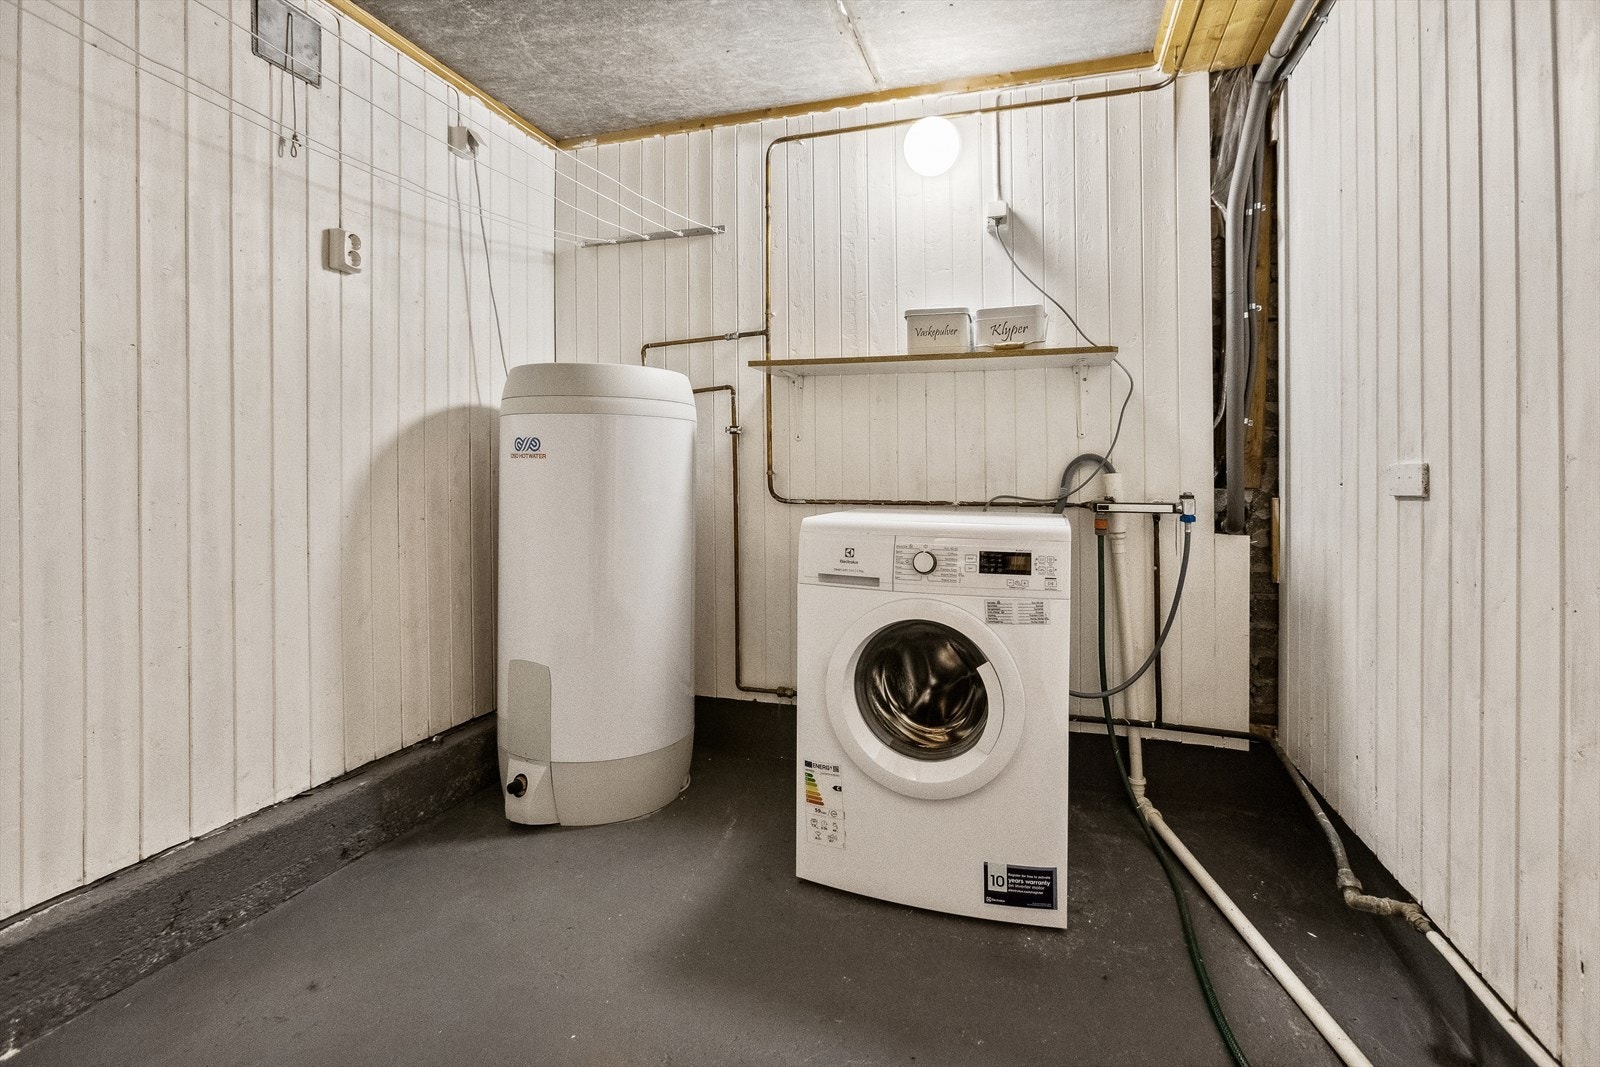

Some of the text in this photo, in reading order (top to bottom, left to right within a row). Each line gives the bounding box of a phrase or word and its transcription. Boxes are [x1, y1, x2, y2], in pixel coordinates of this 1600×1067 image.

[914, 324, 958, 341] Vaskepulver
[990, 321, 1029, 342] Klyper
[990, 874, 1005, 887] 10
